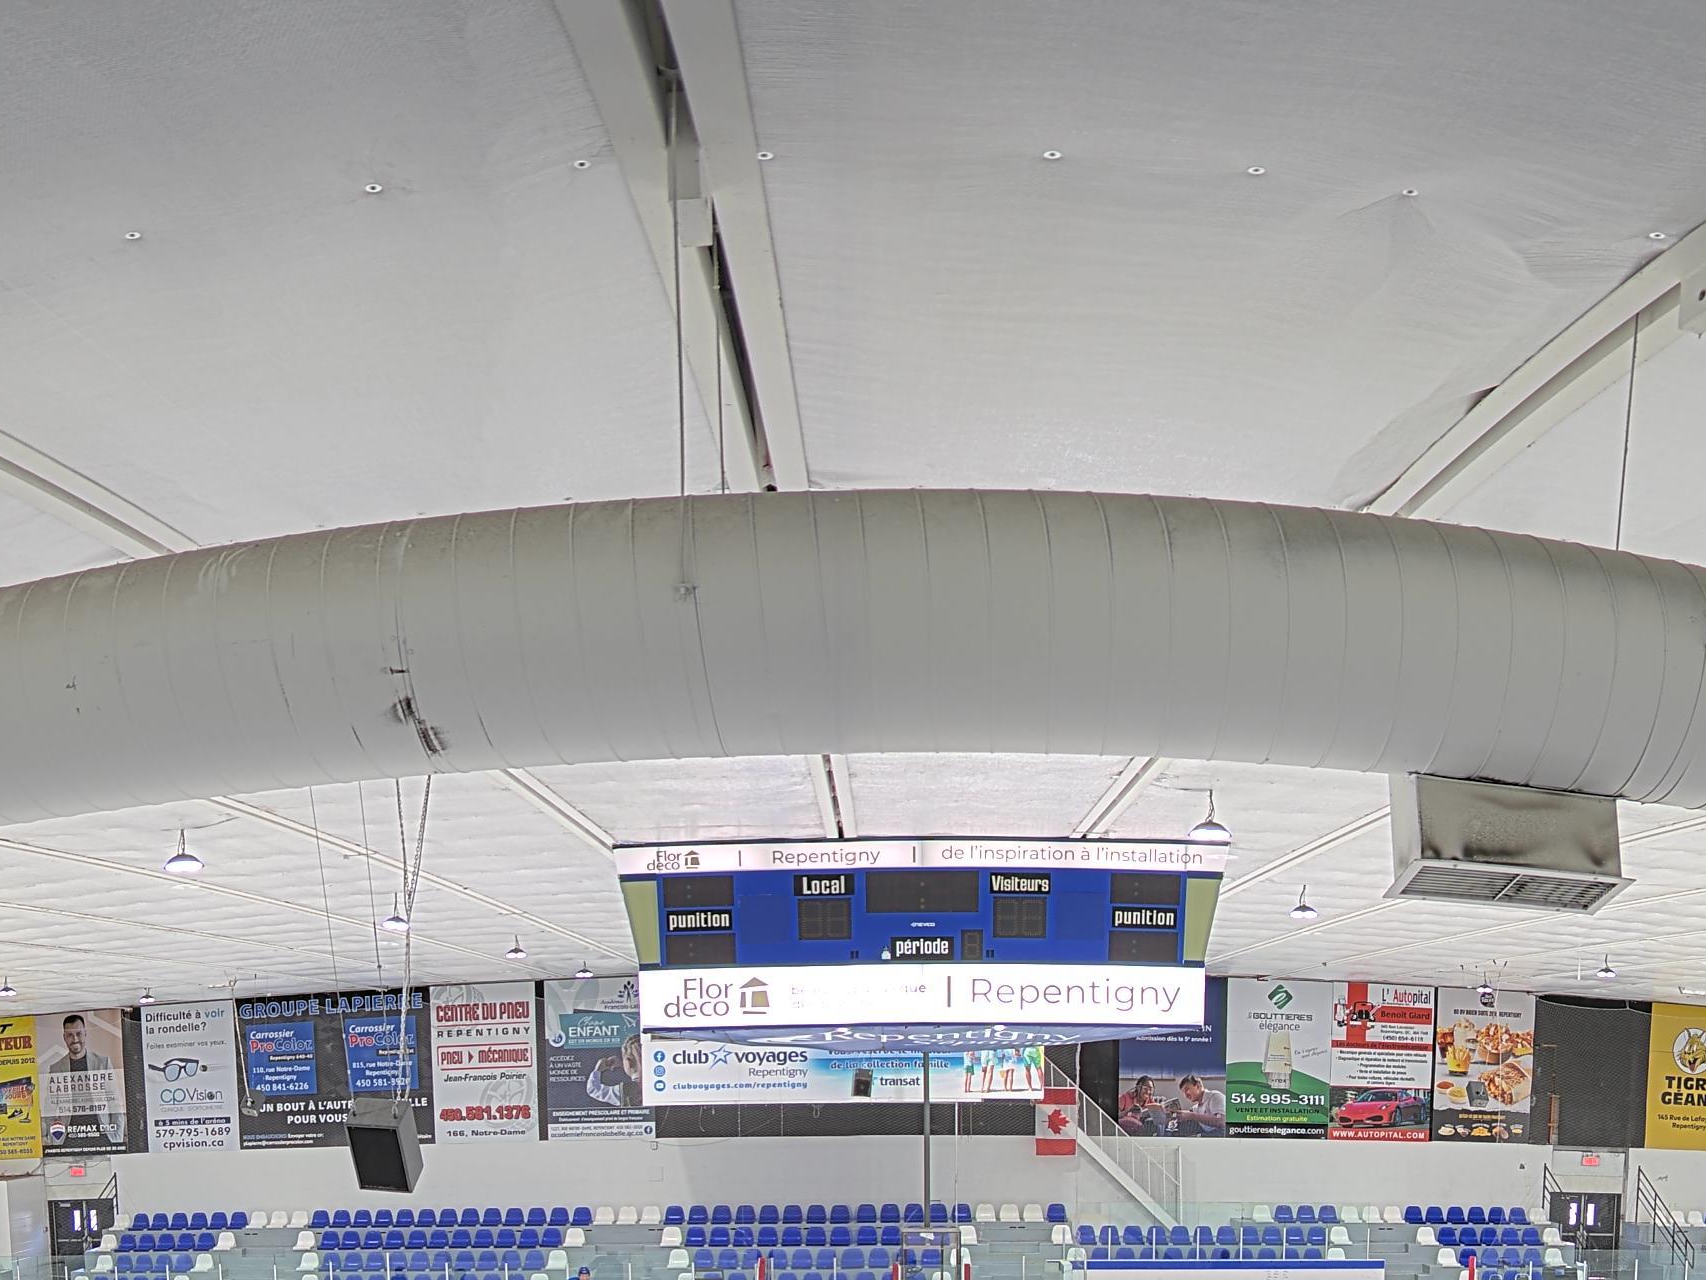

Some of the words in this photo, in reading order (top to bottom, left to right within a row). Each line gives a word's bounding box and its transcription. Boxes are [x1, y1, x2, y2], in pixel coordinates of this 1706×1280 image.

[655, 850, 682, 862] Flor
[772, 848, 881, 866] Repentigny
[941, 846, 965, 860] de
[970, 845, 1075, 866] l'inspiration
[1081, 846, 1091, 861] à
[1096, 846, 1204, 865] l'installation
[646, 860, 680, 871] deco
[802, 875, 846, 894] Local
[991, 874, 1049, 892] Visiteurs
[669, 912, 730, 931] punition
[1115, 910, 1175, 928] punition
[895, 938, 949, 958] période
[682, 977, 734, 999] Flor
[971, 977, 1182, 1013] Repentigny
[1393, 989, 1431, 1006] Autopital
[239, 999, 320, 1019] GROUPE
[436, 1003, 479, 1022] CENTRE
[482, 1002, 497, 1020] DU
[499, 1001, 529, 1019] PNEU
[663, 995, 730, 1018] deco
[145, 1010, 192, 1022] Difficulté
[195, 1010, 201, 1019] à
[204, 1008, 225, 1018] voir
[146, 1026, 154, 1035] la
[158, 1022, 207, 1034] rondelle?
[349, 1024, 395, 1033] Carrossier
[437, 1027, 530, 1038] REPENTIGNY
[568, 1026, 620, 1037] ENFANT
[1259, 1021, 1301, 1033] élégance
[250, 1029, 294, 1039] Carrossier
[822, 1027, 1081, 1043] Repentigny
[441, 1051, 463, 1065] PNEU
[478, 1047, 528, 1063] MÉCANIQUE
[672, 1049, 709, 1065] club
[734, 1050, 808, 1067] voyages
[276, 1065, 310, 1073] Notre-Dame
[863, 1060, 912, 1069] collection
[50, 1073, 113, 1084] ALEXANDRE
[444, 1073, 497, 1083] Jean-François
[500, 1072, 526, 1080] Poirier
[748, 1067, 808, 1079] Repentigny
[272, 1082, 309, 1091] 841-6226
[672, 1080, 808, 1091] clubvoyages.com/repentigny
[880, 1075, 921, 1087] transat
[50, 1082, 105, 1093] LABROSSE
[276, 1100, 304, 1111] BOUT
[308, 1098, 316, 1110] À
[1230, 1094, 1256, 1103] 514
[1260, 1094, 1325, 1105] 995-3111
[287, 1114, 317, 1124] POUR
[318, 1113, 348, 1123] VOUS
[1246, 1114, 1281, 1122] Estimation
[1282, 1115, 1308, 1123] gratuite
[155, 1127, 231, 1138] 579-795-1689
[1229, 1126, 1324, 1136] gouttiereselegance.com
[1672, 1123, 1706, 1131] Repentigny
[1332, 1130, 1425, 1139] WWW.AUTOPITAL.COM
[163, 1139, 224, 1151] cpvision.ca
